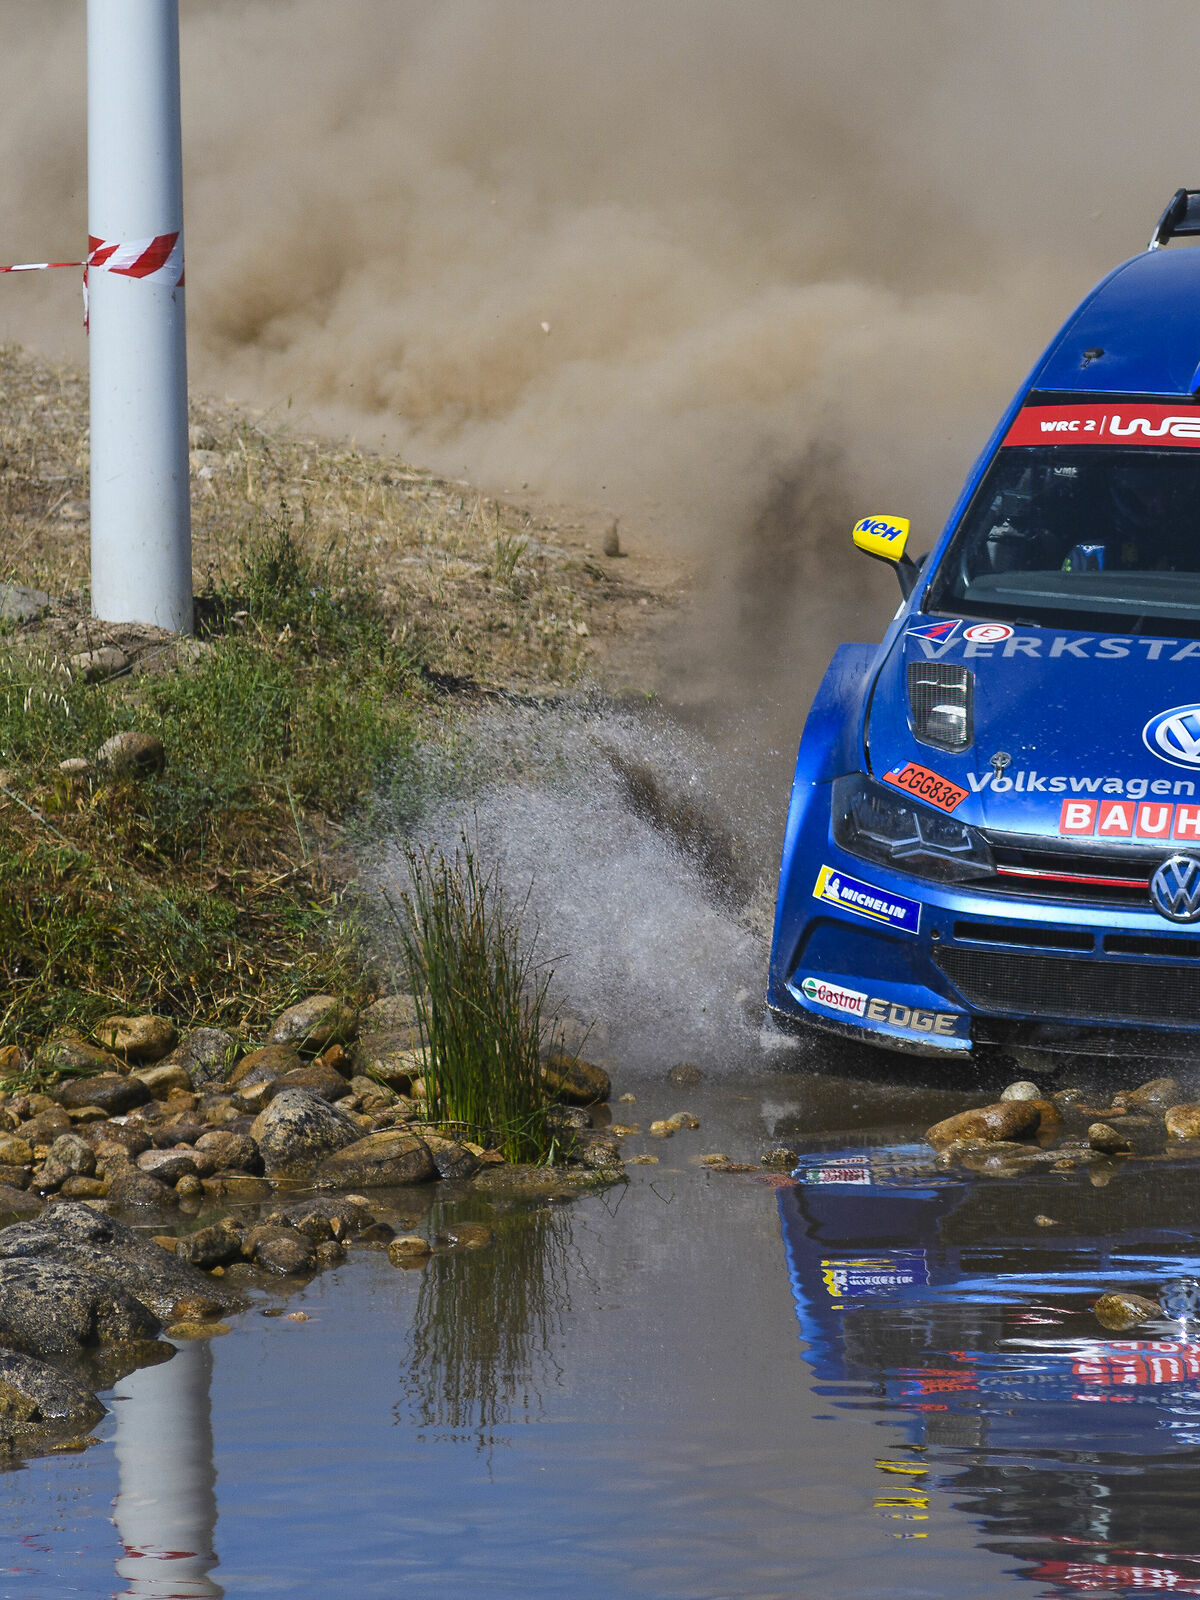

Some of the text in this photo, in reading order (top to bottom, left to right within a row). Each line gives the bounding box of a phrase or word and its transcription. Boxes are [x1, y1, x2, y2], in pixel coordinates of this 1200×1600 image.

[1040, 420, 1081, 432] WRC
[1083, 420, 1097, 431] 2
[979, 628, 998, 638] E
[899, 768, 962, 807] CGG836
[966, 771, 1195, 800] Volkswagen
[840, 886, 907, 919] MICHELIN
[817, 984, 959, 1036] Castrol EDGE
